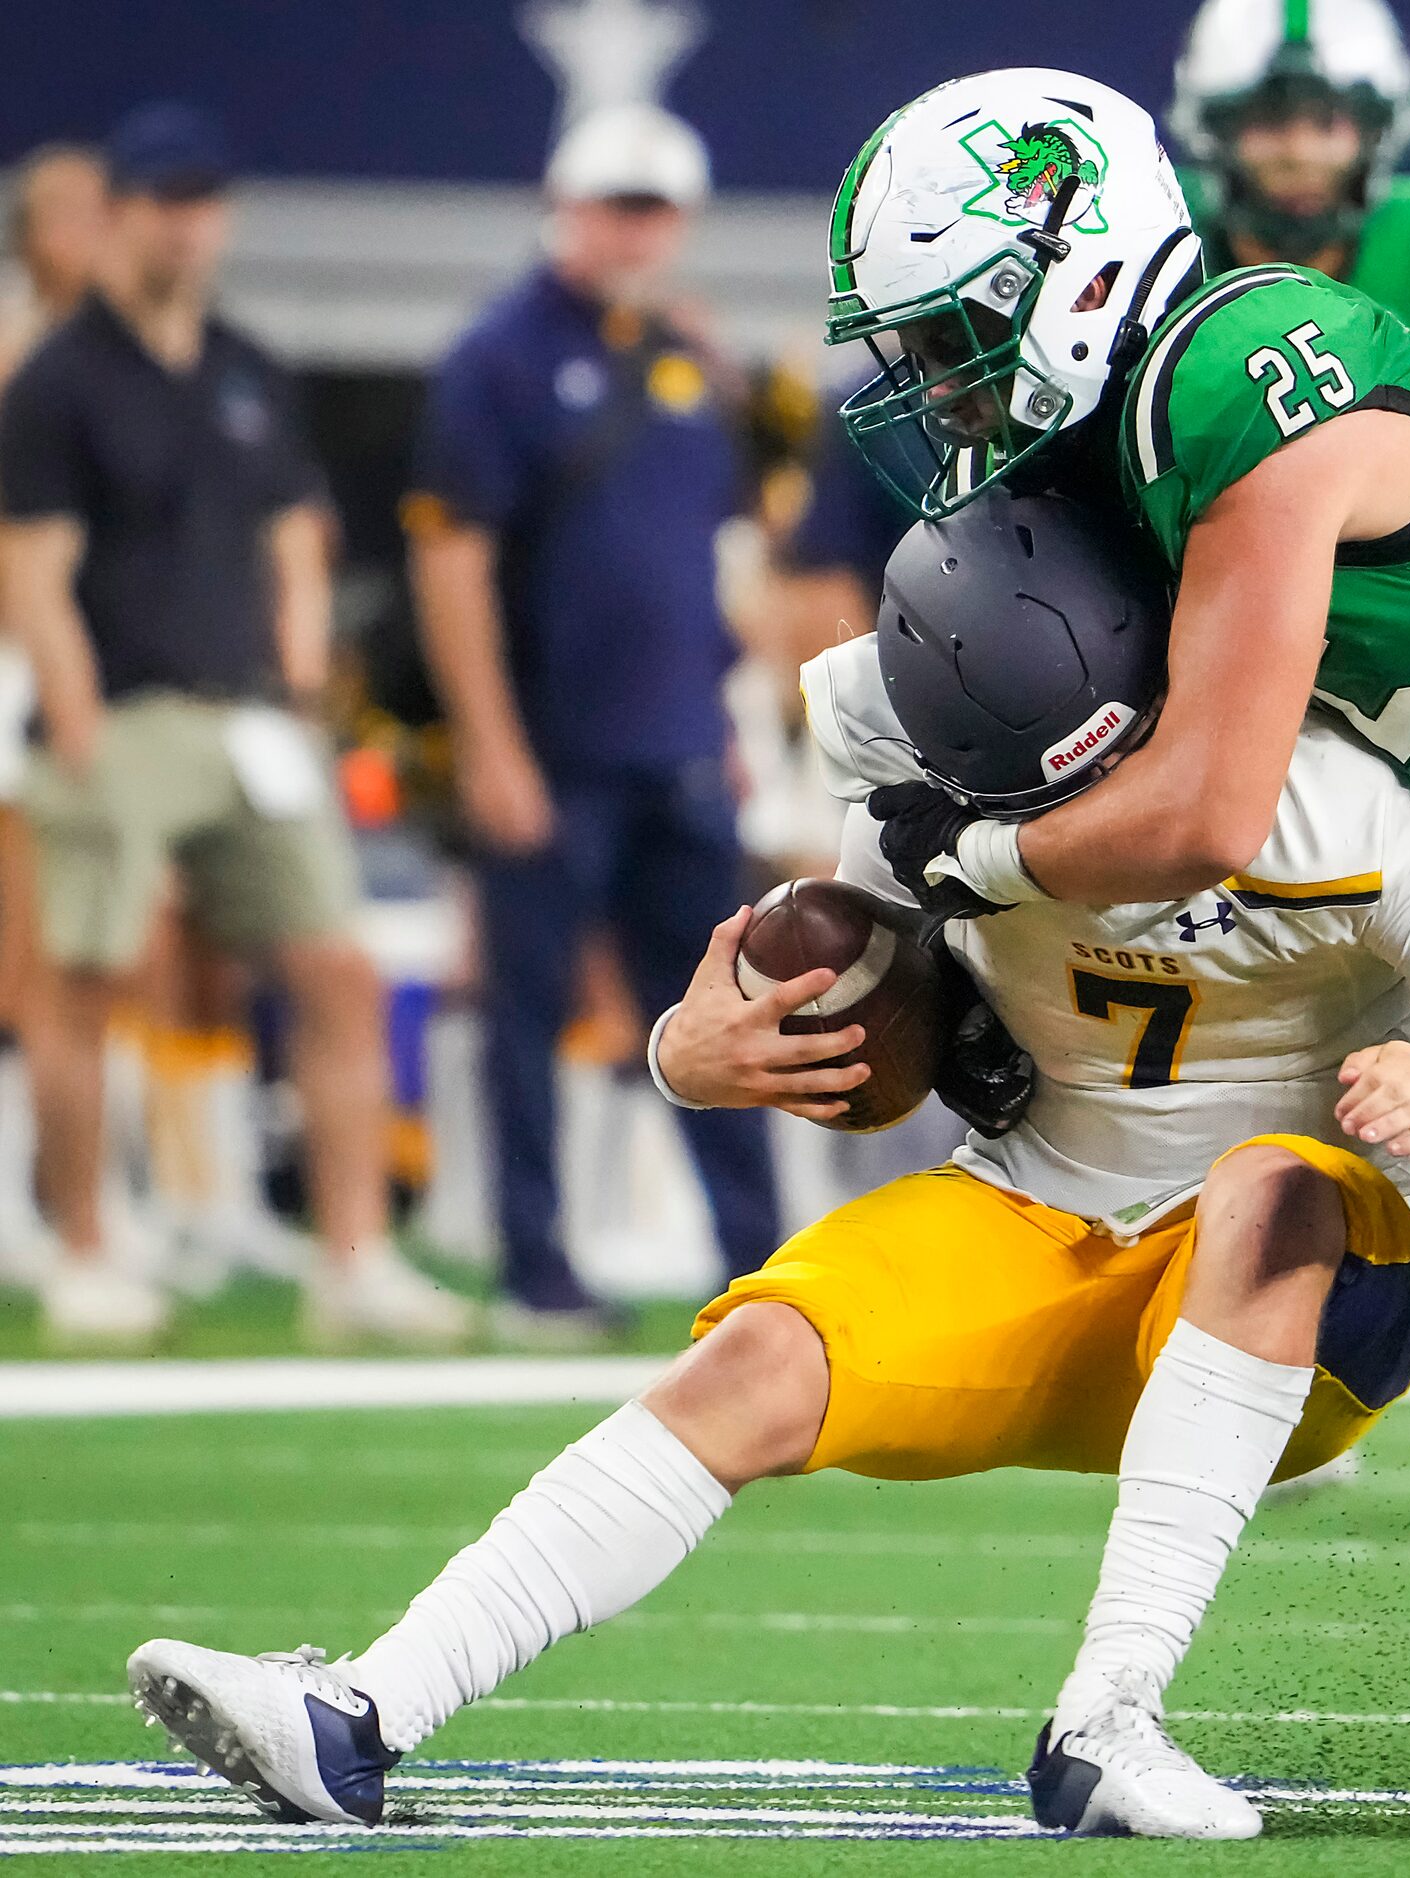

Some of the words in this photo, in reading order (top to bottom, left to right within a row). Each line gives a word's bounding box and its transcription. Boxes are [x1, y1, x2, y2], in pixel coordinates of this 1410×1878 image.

[1244, 320, 1356, 440] 25
[1048, 711, 1120, 771] Riddell
[1072, 942, 1181, 975] SCOTS
[1065, 962, 1203, 1091] 7
